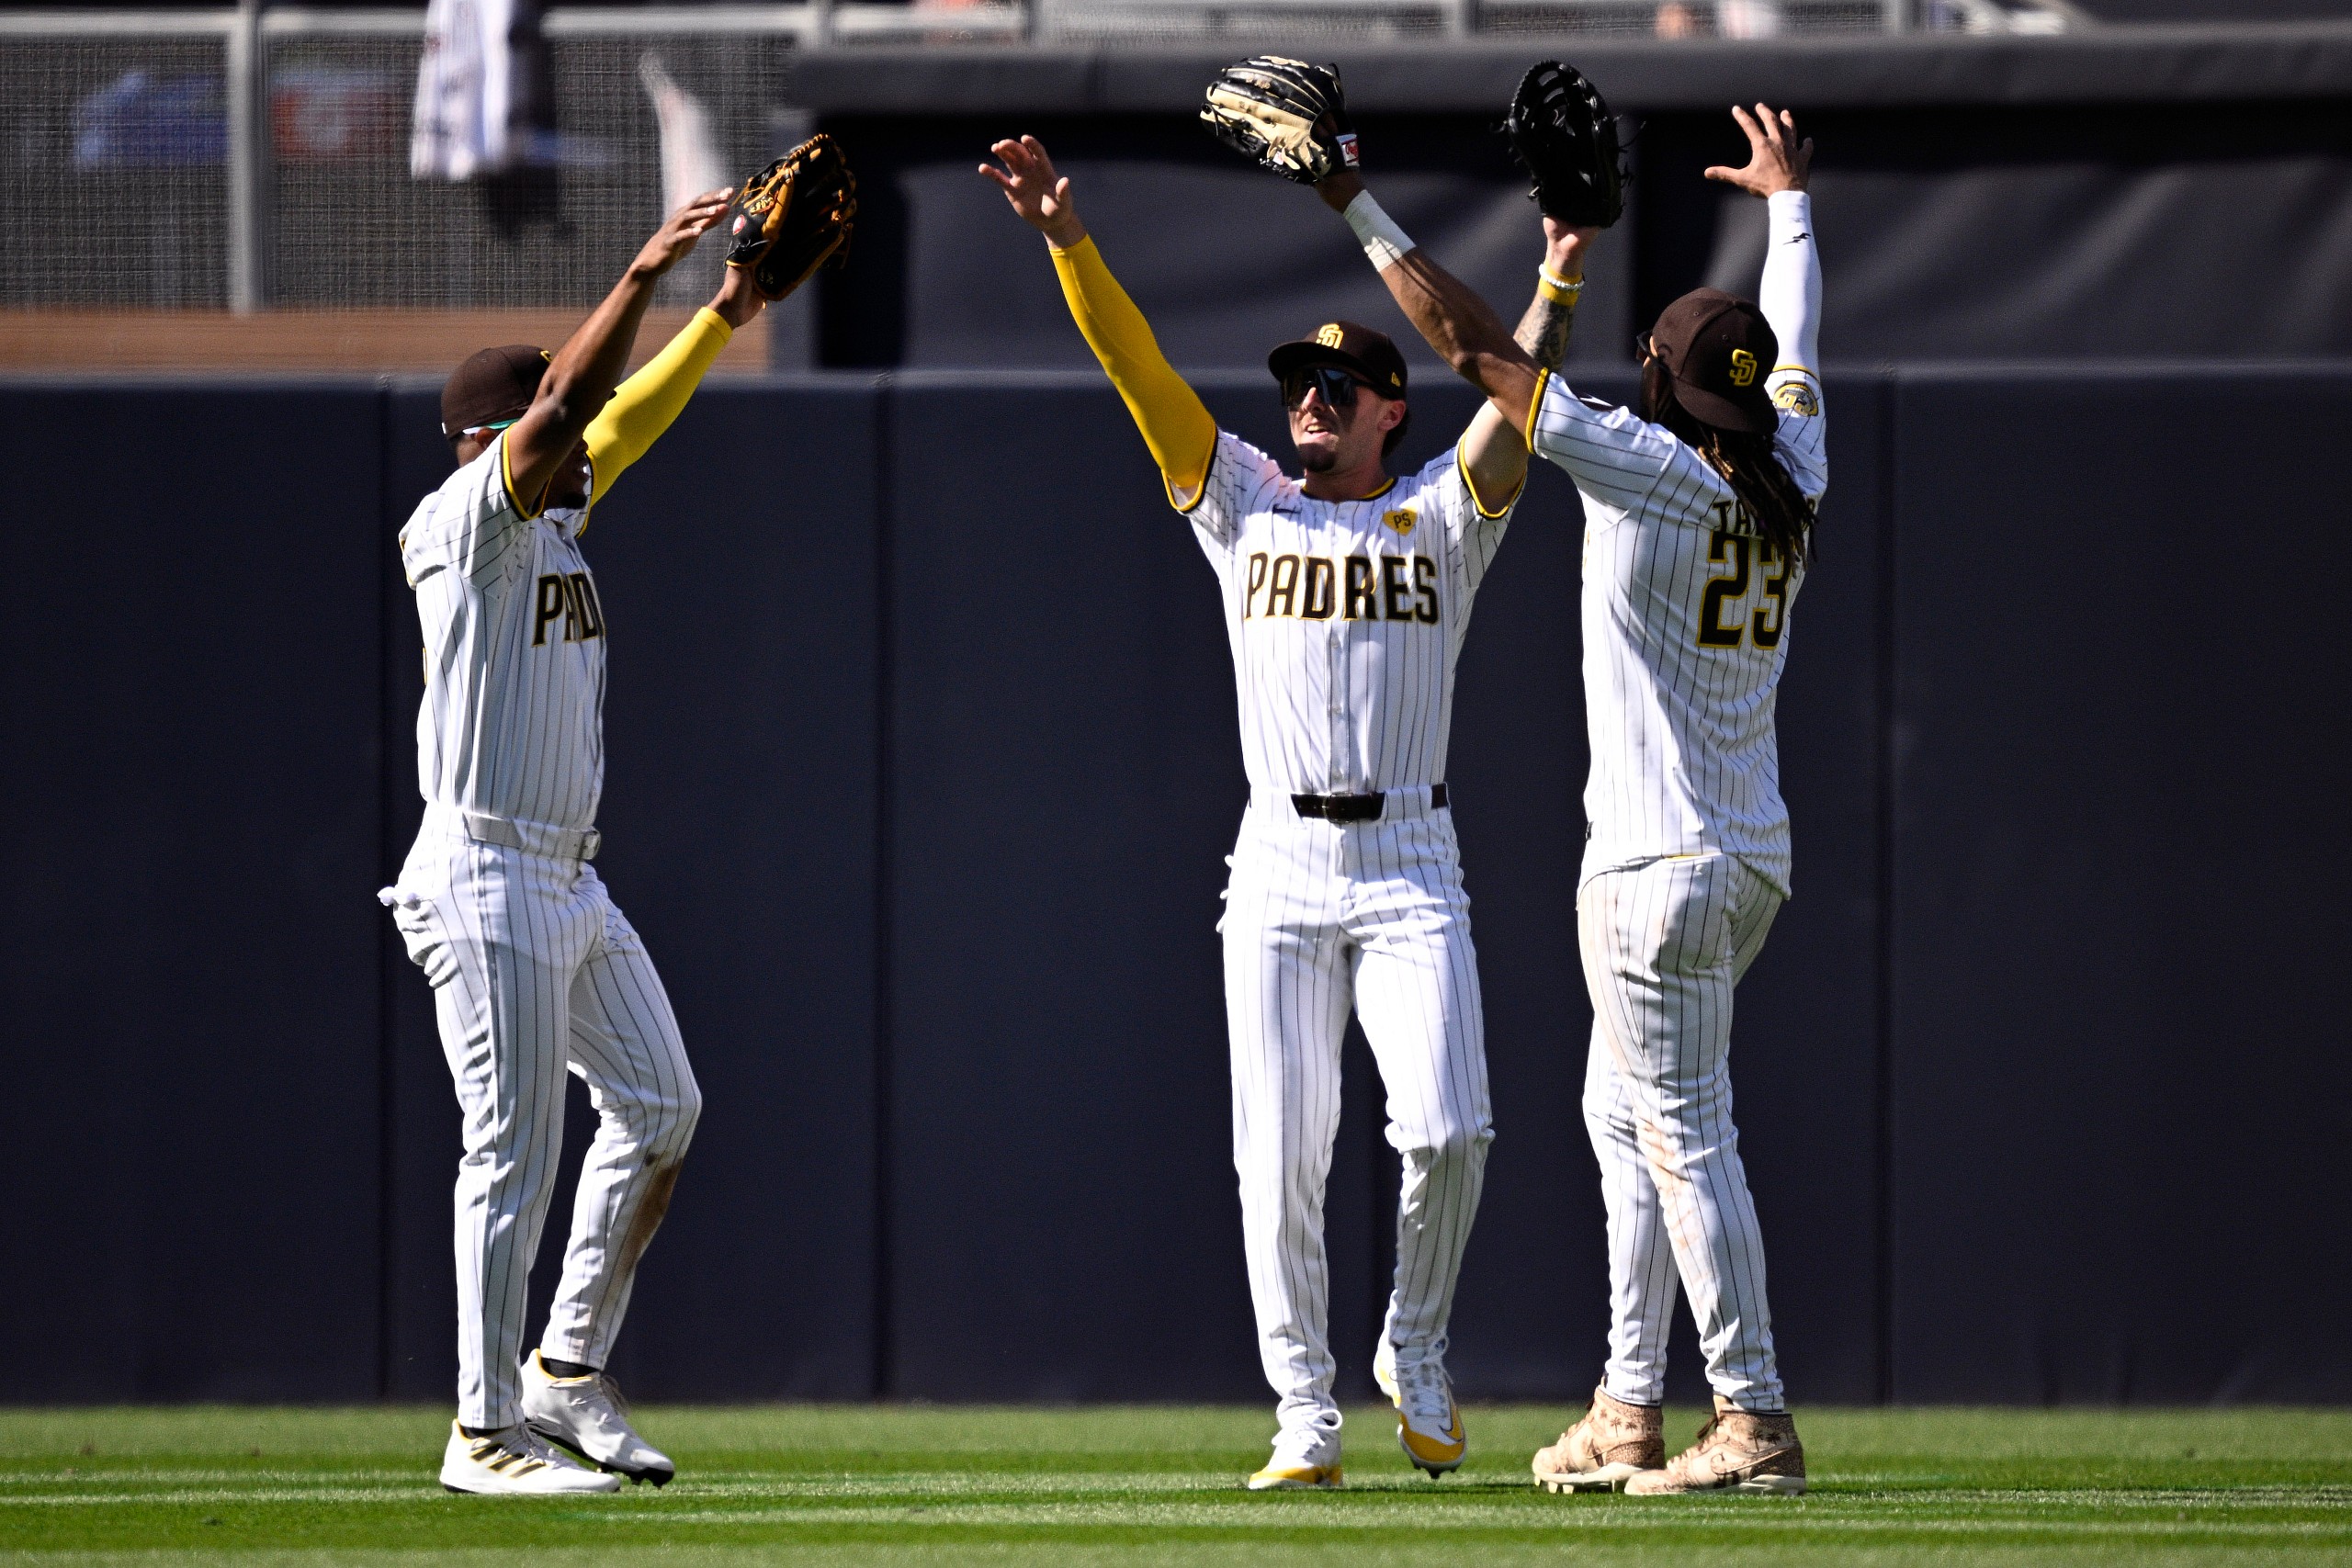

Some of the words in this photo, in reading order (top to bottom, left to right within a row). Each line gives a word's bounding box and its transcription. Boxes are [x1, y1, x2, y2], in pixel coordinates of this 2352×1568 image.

[1729, 348, 1758, 387] SD
[1393, 512, 1412, 529] PS
[1244, 550, 1440, 626] PADRES
[1696, 530, 1795, 650] 23
